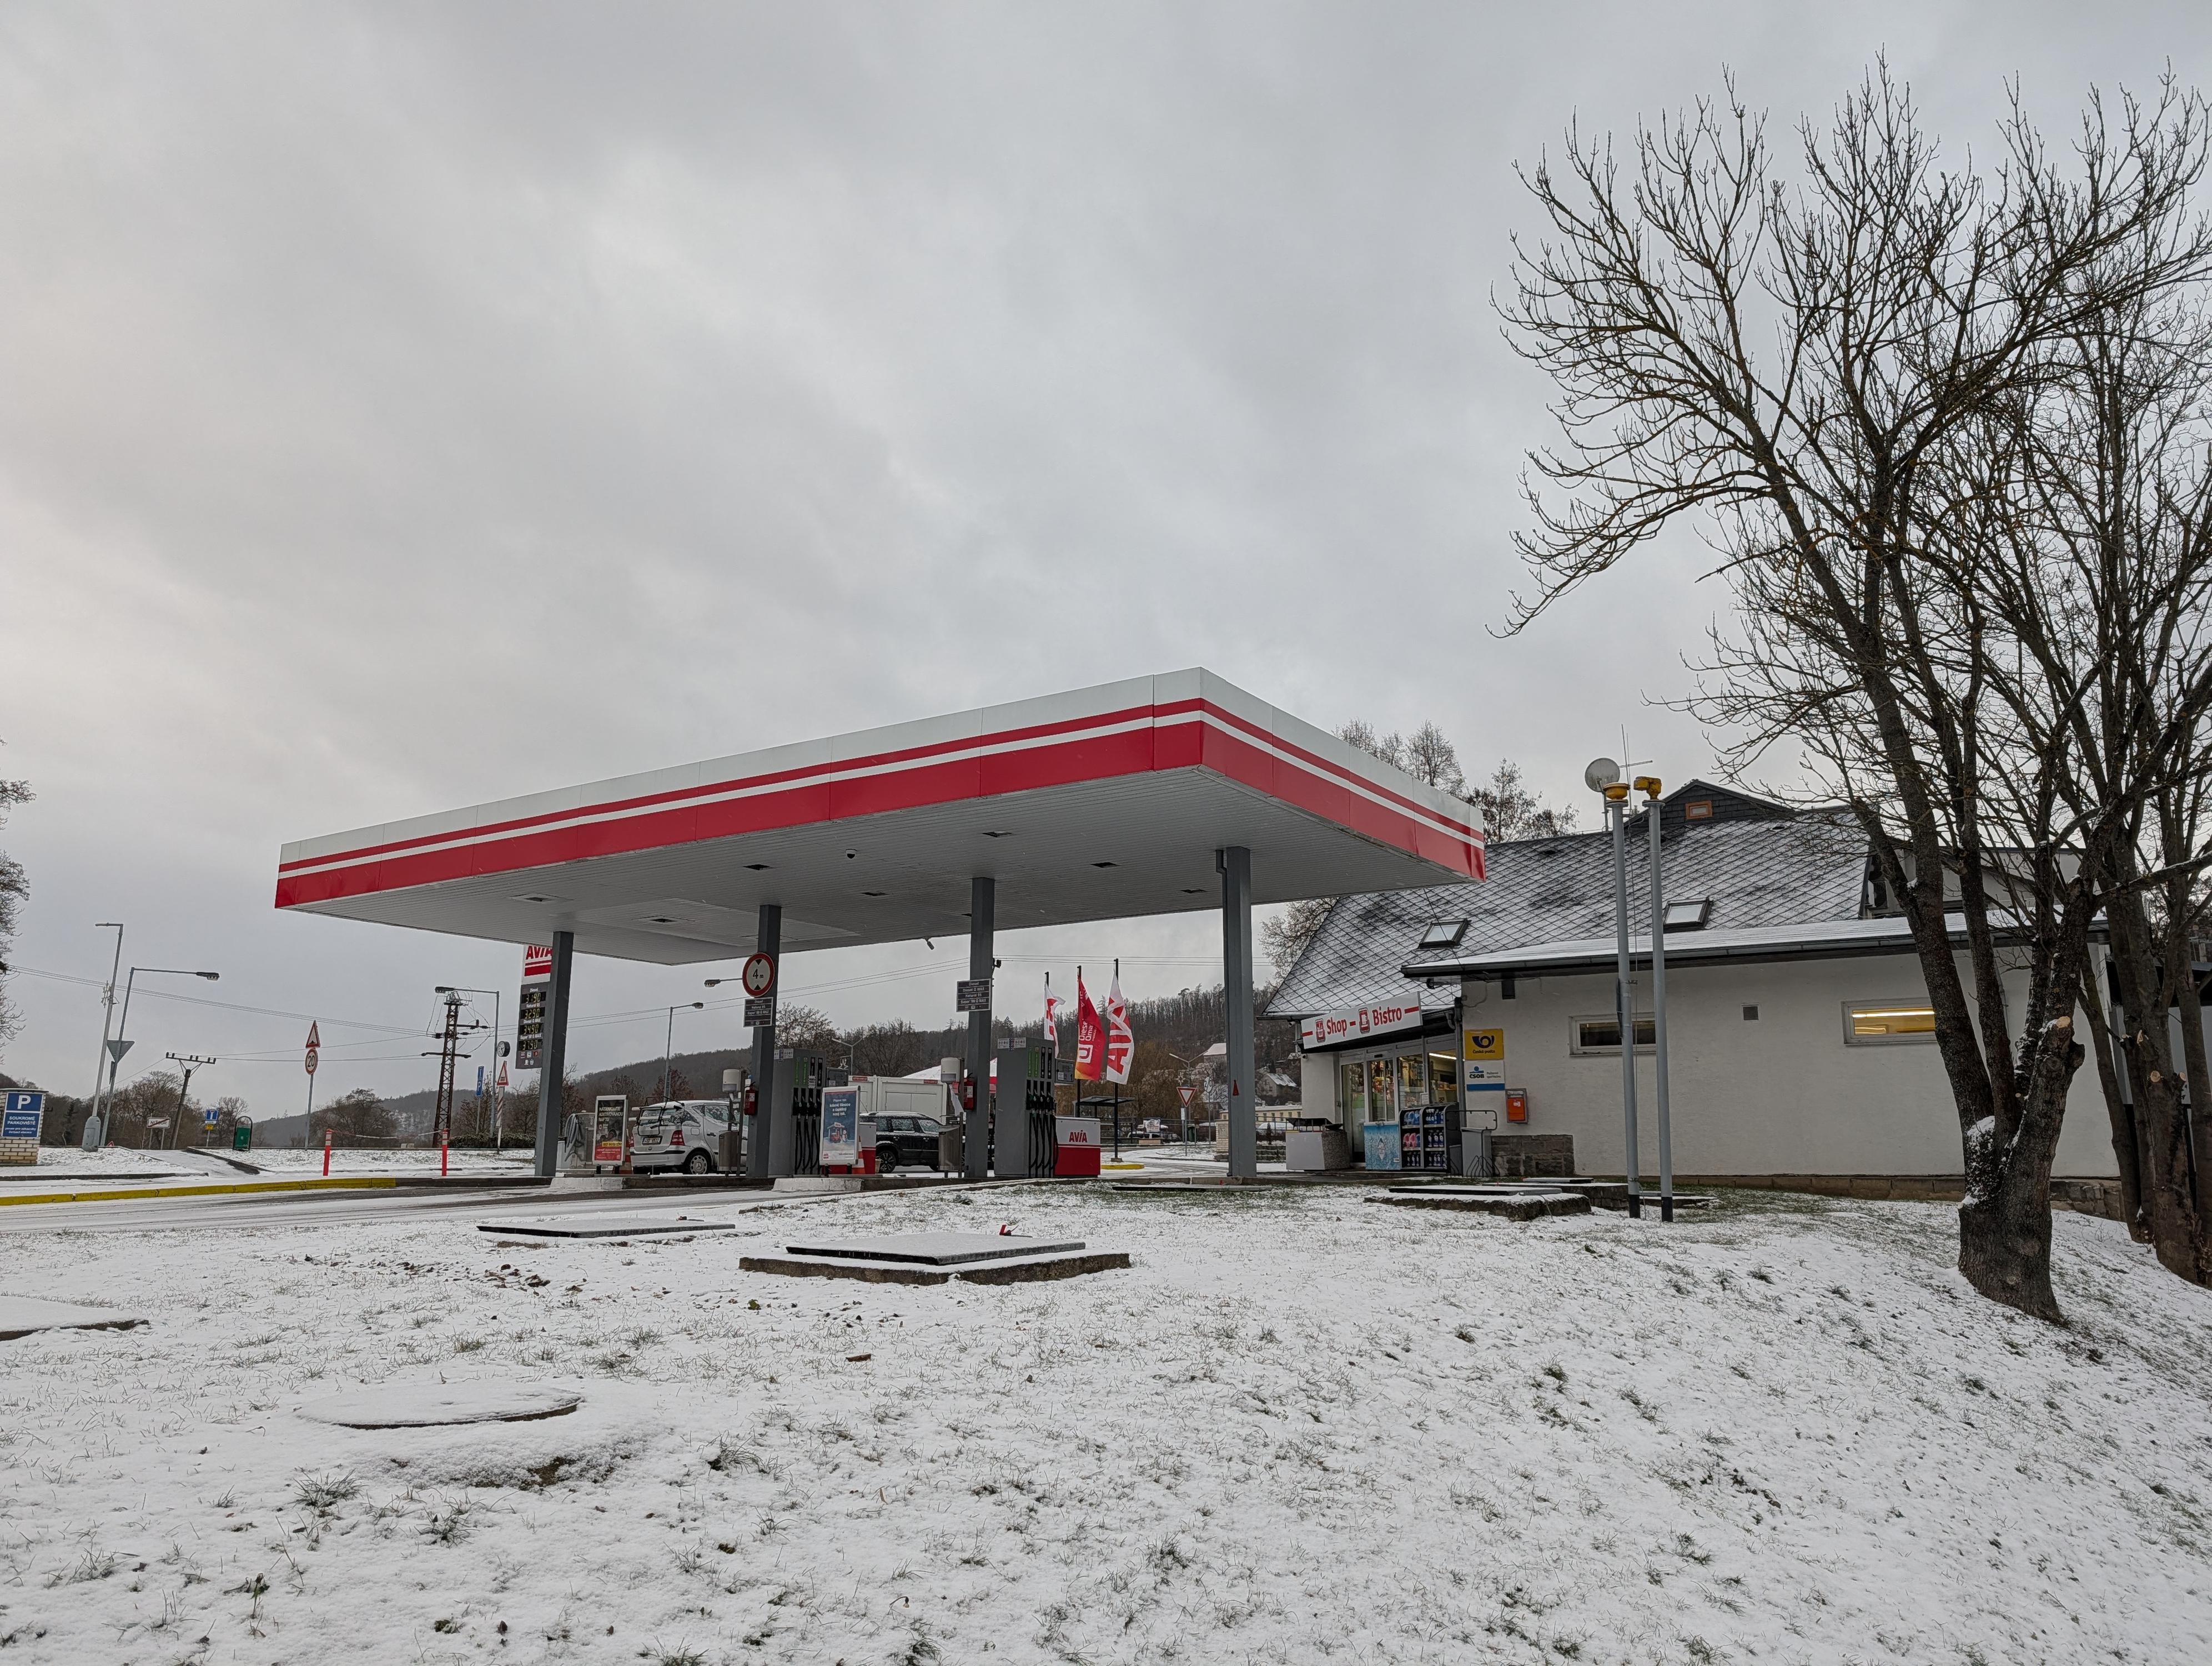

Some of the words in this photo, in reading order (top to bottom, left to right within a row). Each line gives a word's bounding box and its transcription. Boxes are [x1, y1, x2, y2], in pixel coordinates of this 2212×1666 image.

[753, 969, 758, 979] 4
[525, 1008, 540, 1019] 3290
[1326, 1017, 1348, 1037] Shop
[1372, 1006, 1402, 1026] Bistro
[524, 1024, 539, 1035] 3490
[522, 1040, 538, 1050] 3790
[308, 1055, 315, 1067] 20
[17, 1095, 31, 1110] P
[1069, 1129, 1088, 1143] AVIA
